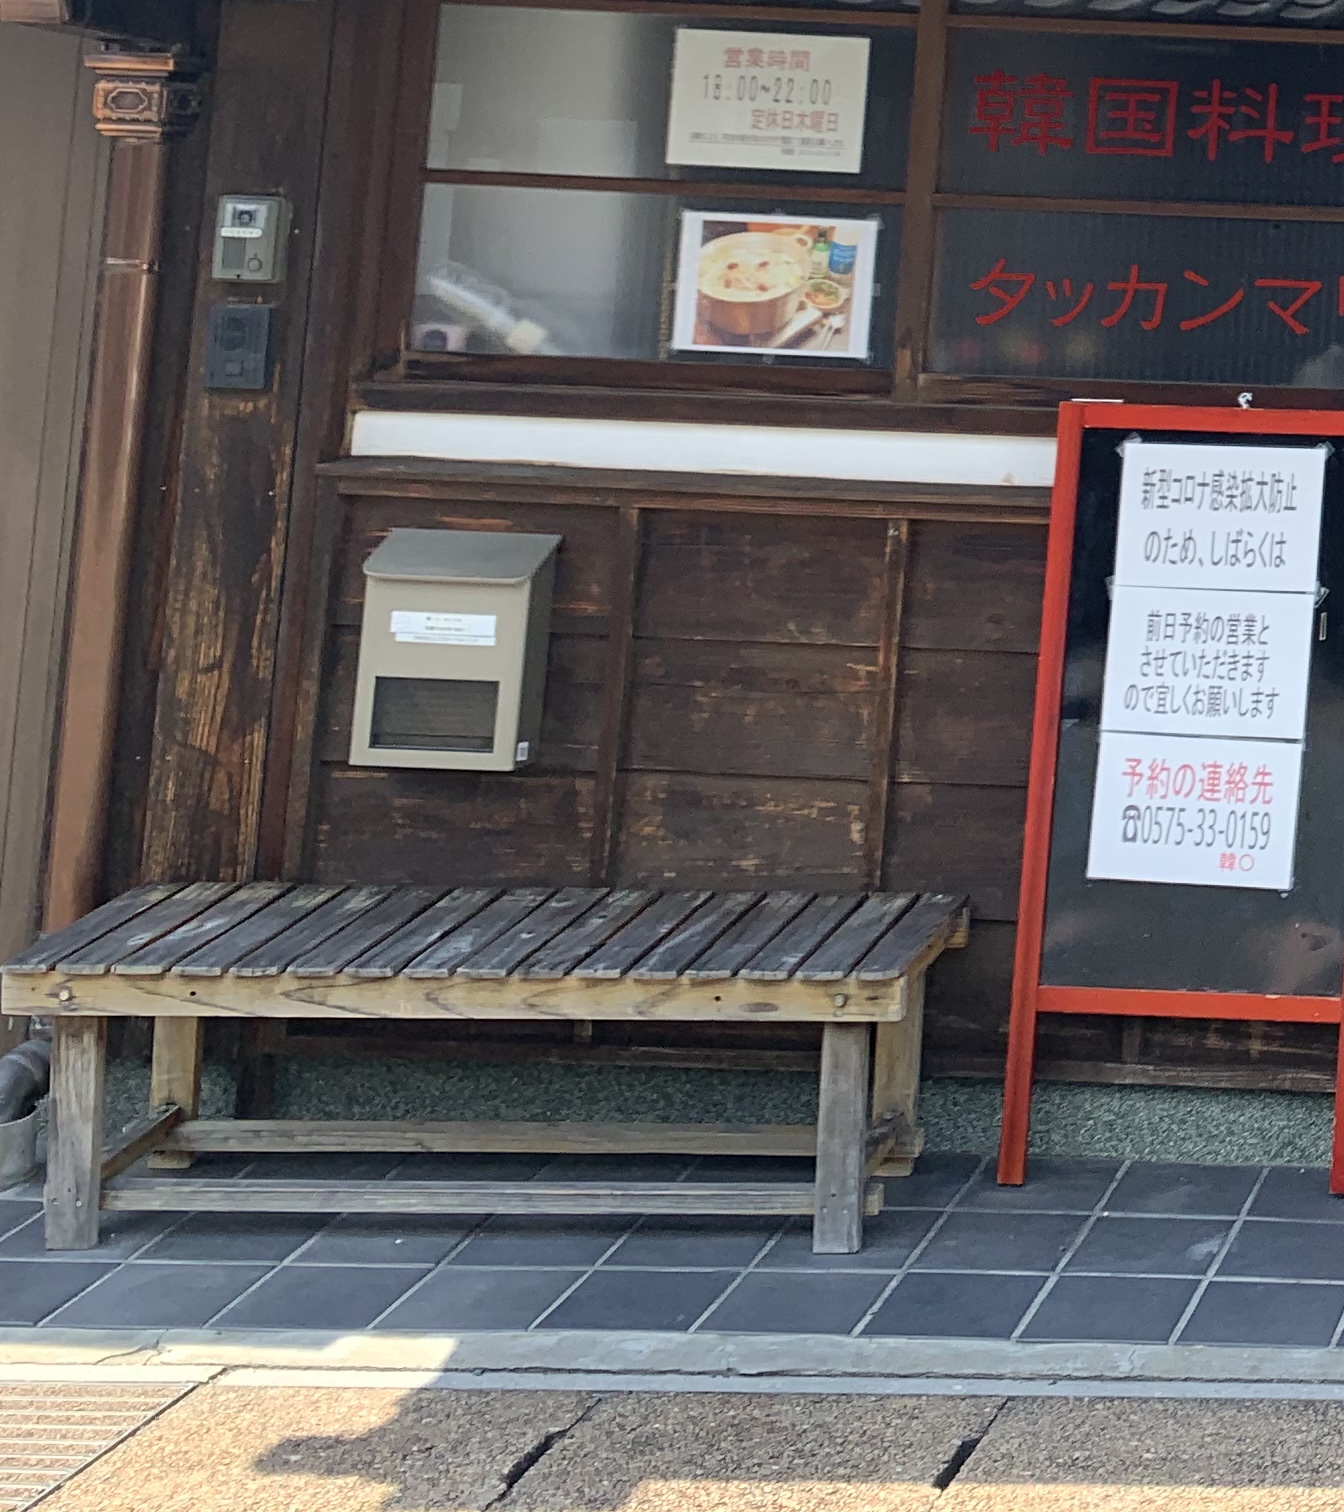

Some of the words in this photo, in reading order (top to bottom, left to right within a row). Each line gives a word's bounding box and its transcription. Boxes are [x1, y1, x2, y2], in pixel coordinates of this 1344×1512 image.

[723, 47, 813, 72] 営業時間
[750, 108, 841, 134] 定休日木曜日
[1140, 467, 1298, 514] 新型コロナ感染拡大防止
[1143, 528, 1288, 569] のため、しばらくは
[1145, 609, 1271, 646] 前日予約の営業と
[1139, 645, 1271, 684] させていただきます
[1123, 682, 1281, 720] ので宜しくお願いします
[1121, 756, 1275, 806] 予約の連絡先
